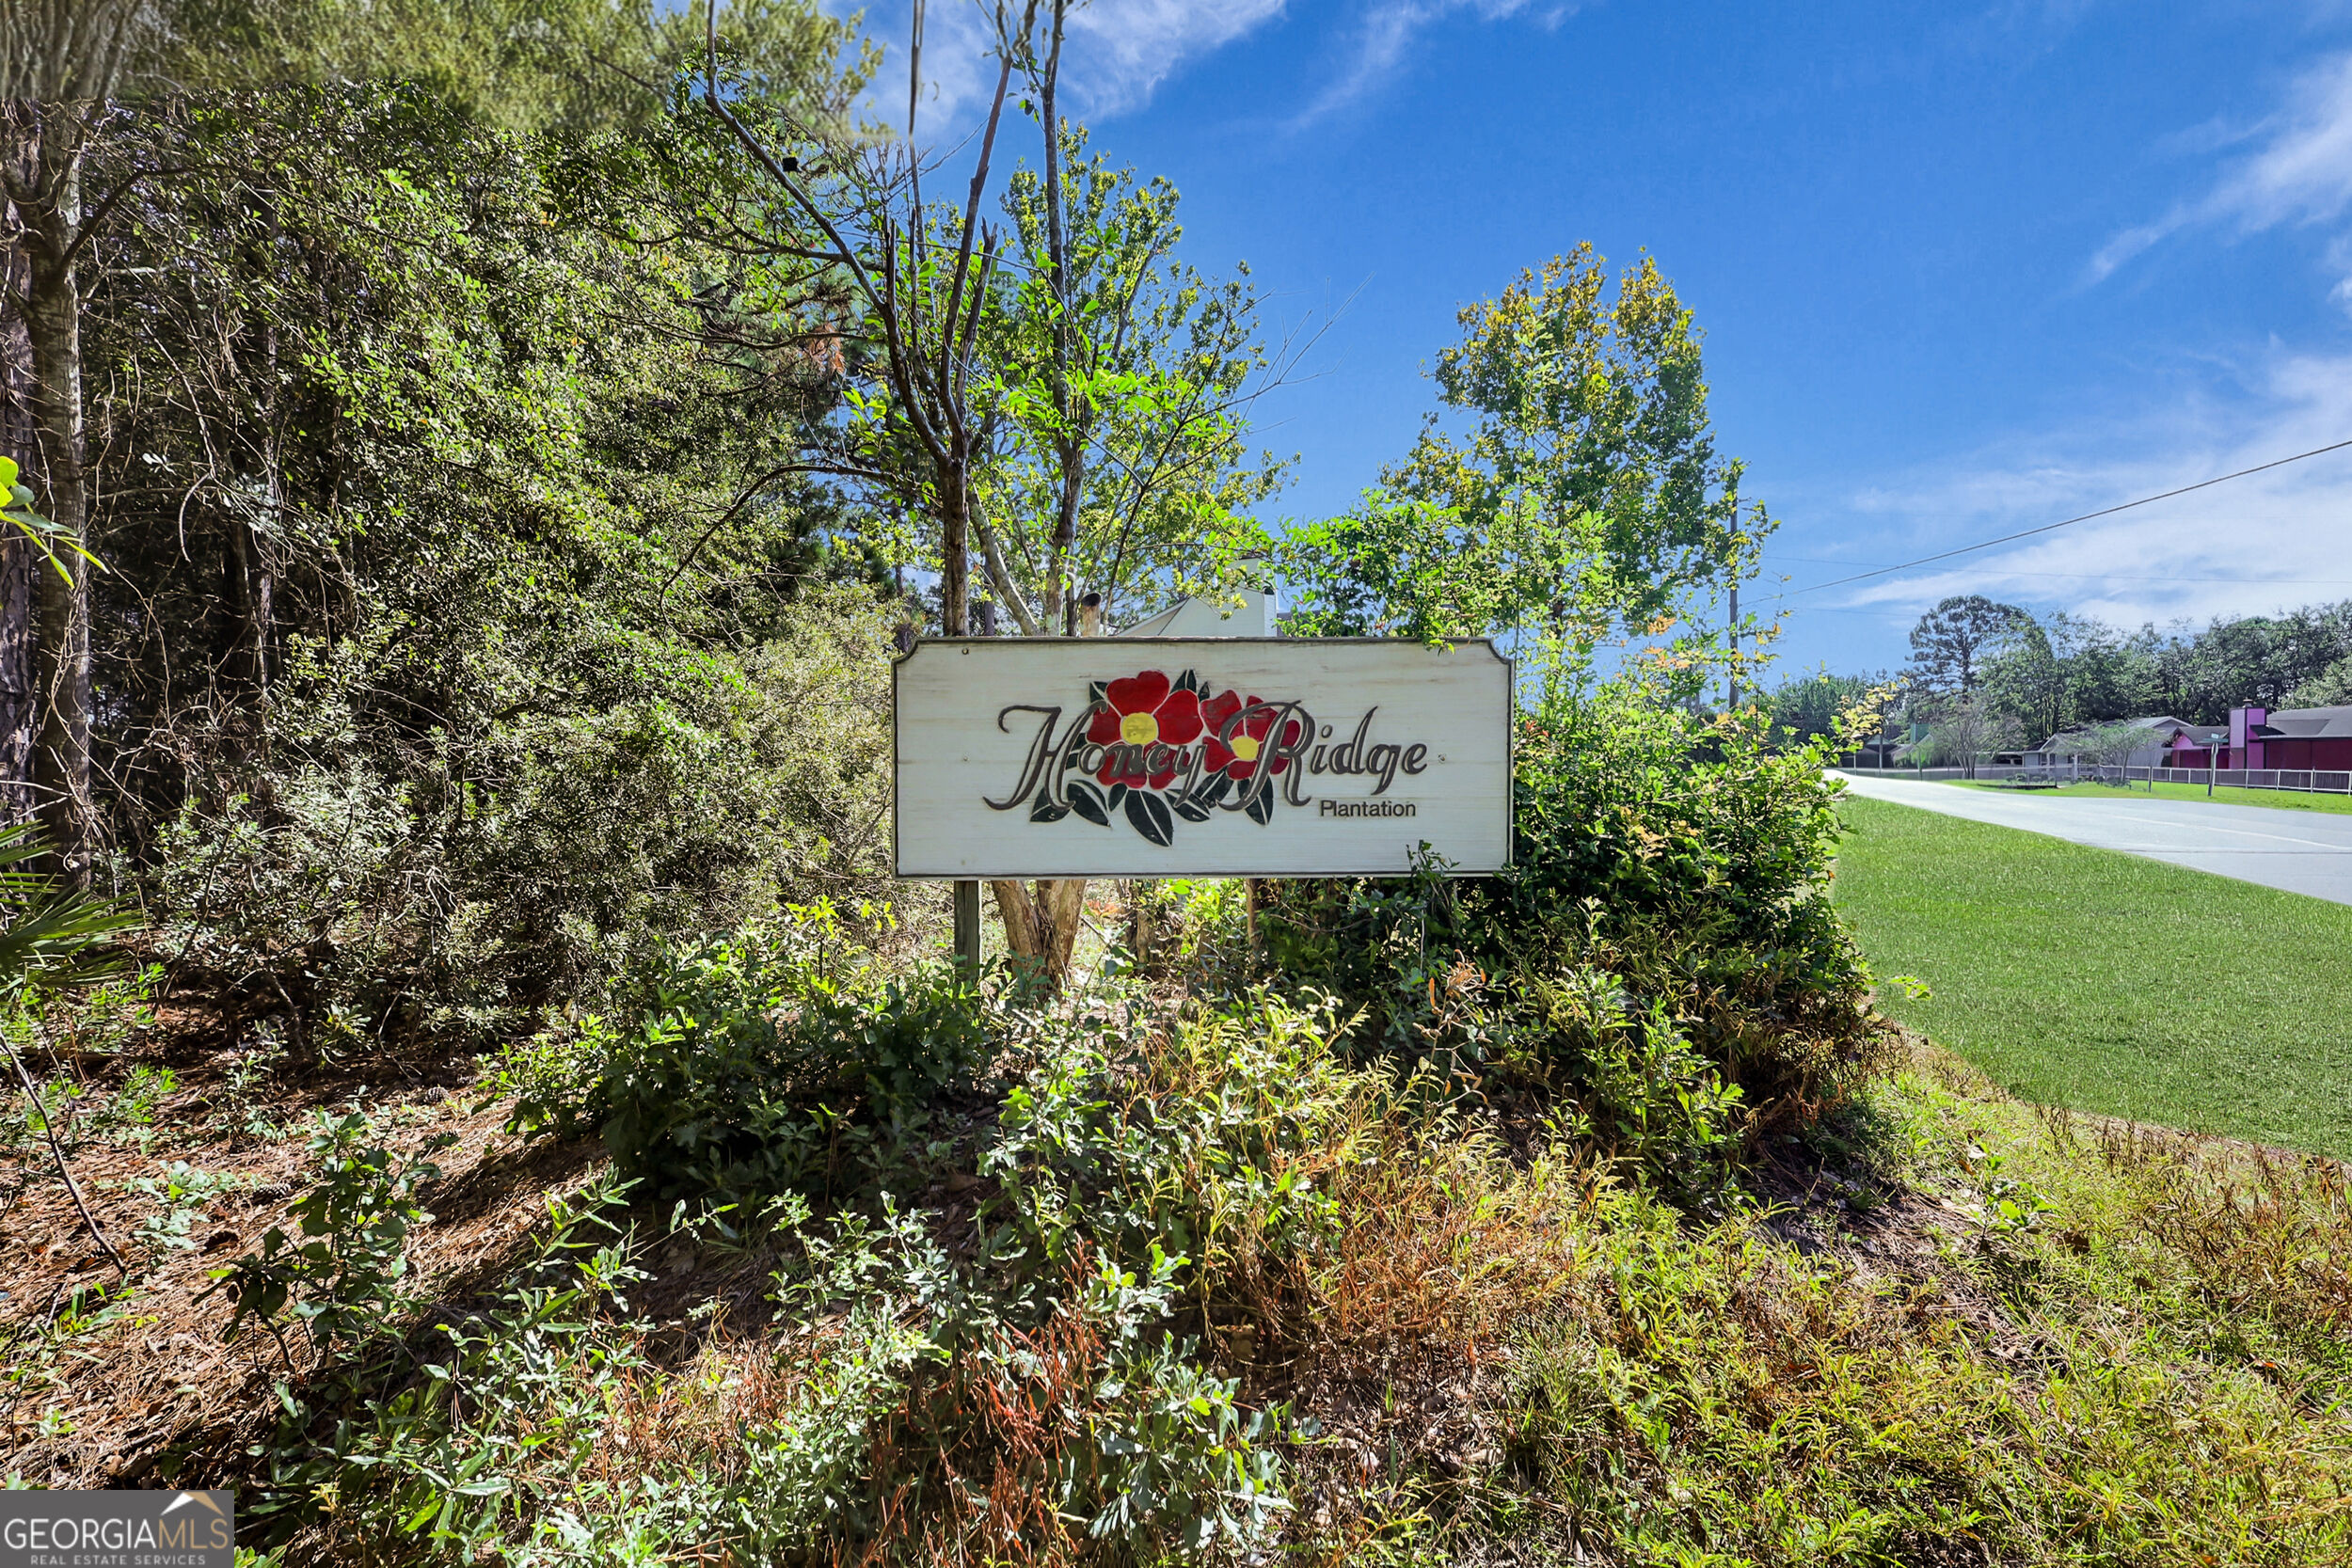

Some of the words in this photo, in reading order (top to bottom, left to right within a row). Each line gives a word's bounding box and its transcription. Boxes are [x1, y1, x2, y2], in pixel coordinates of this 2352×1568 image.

[981, 700, 1208, 811] Honey
[1216, 699, 1428, 812] Ridge
[1319, 799, 1418, 818] Plantation
